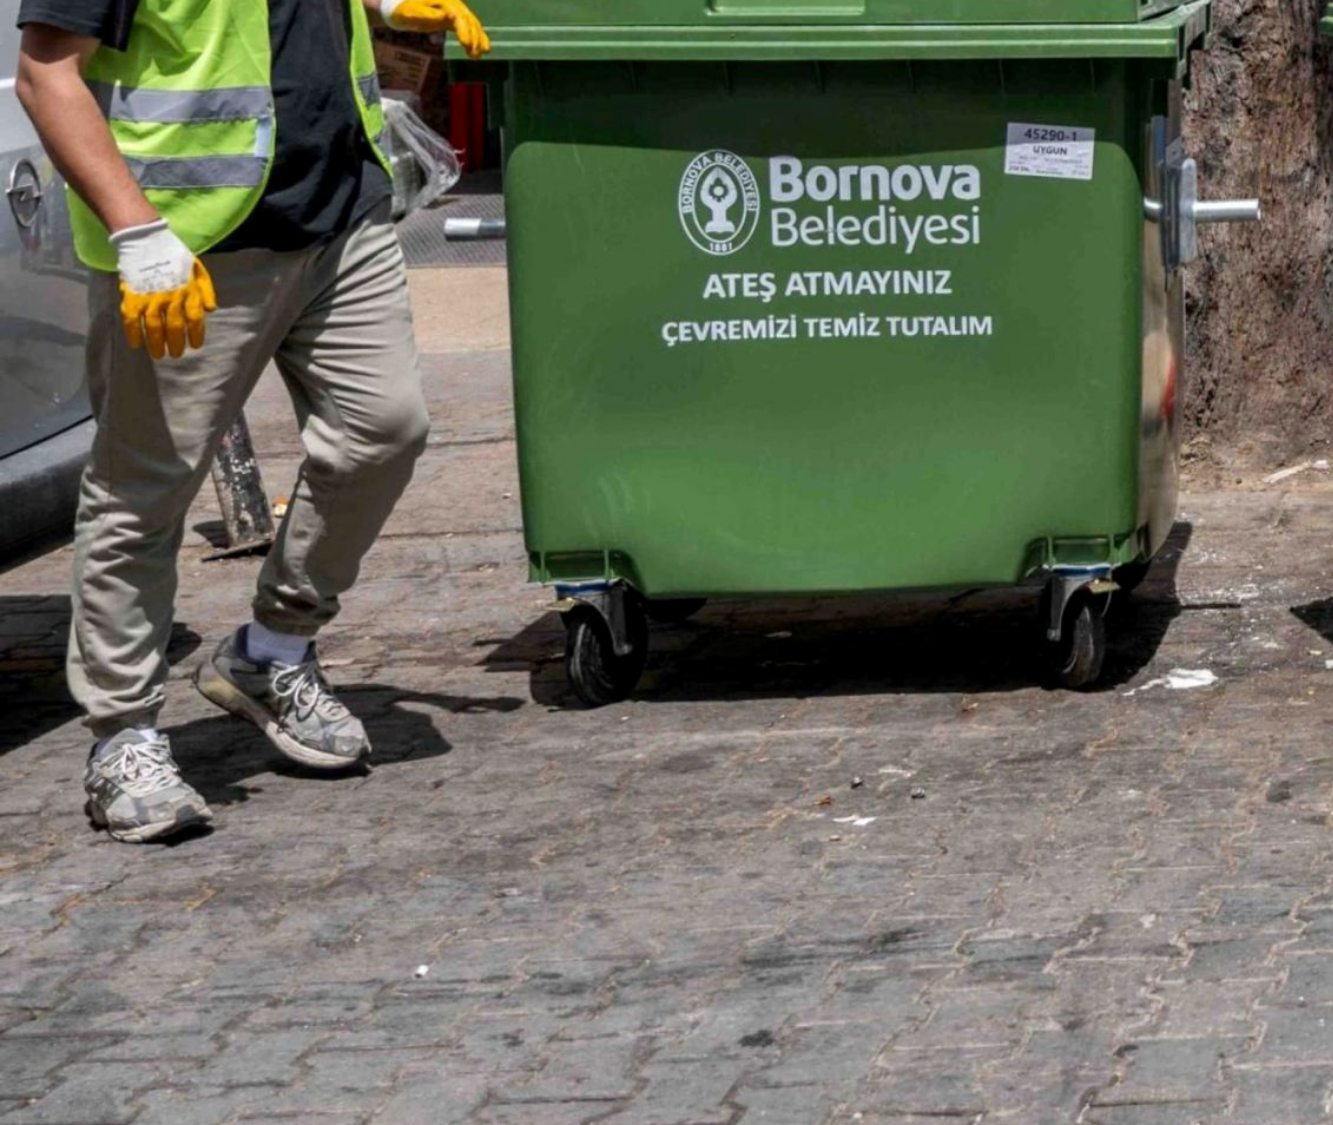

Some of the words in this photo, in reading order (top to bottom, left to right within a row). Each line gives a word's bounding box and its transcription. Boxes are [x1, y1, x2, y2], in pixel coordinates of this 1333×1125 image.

[1023, 127, 1078, 142] 45290-1
[1033, 145, 1068, 156] UYGUN
[768, 155, 982, 203] Bornova
[771, 205, 981, 254] Belediyesi
[703, 272, 777, 303] ATEŞ
[785, 270, 953, 297] ATMAYINIZ
[661, 314, 797, 347] ÇEVREMİZİ
[804, 312, 880, 338] TEMİZ
[886, 315, 993, 338] TUTALIM
